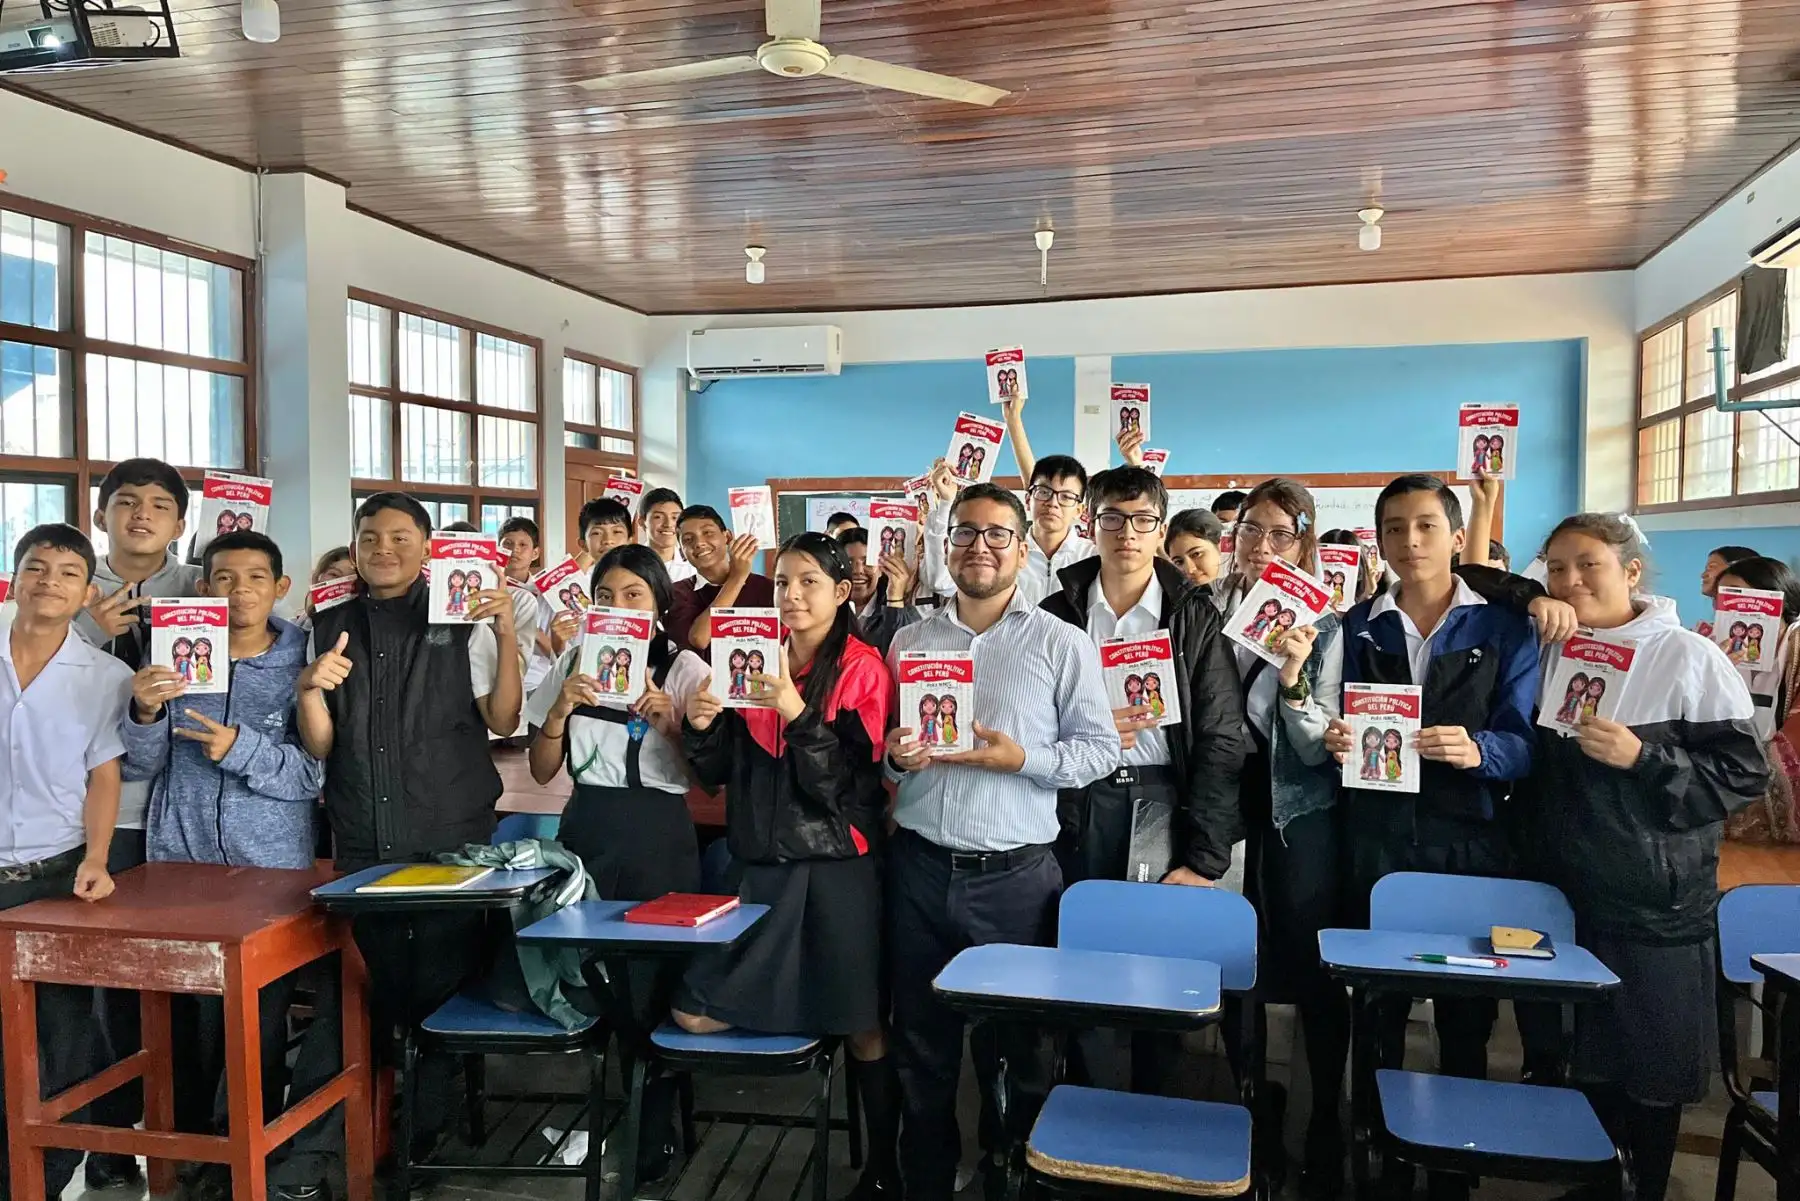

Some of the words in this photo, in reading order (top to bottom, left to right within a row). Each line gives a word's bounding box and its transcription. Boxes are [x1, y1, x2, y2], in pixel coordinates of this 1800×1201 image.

[1109, 645, 1141, 660] CONSTITUCIÓN
[1143, 645, 1164, 653] POLÍTICA
[907, 662, 942, 676] CONSTITUCIÓN
[944, 664, 965, 676] POLÍTICA
[1352, 696, 1388, 707] CONSTITUCIÓN
[1389, 697, 1412, 712] POLÍTICA
[1380, 704, 1395, 712] PERÚ
